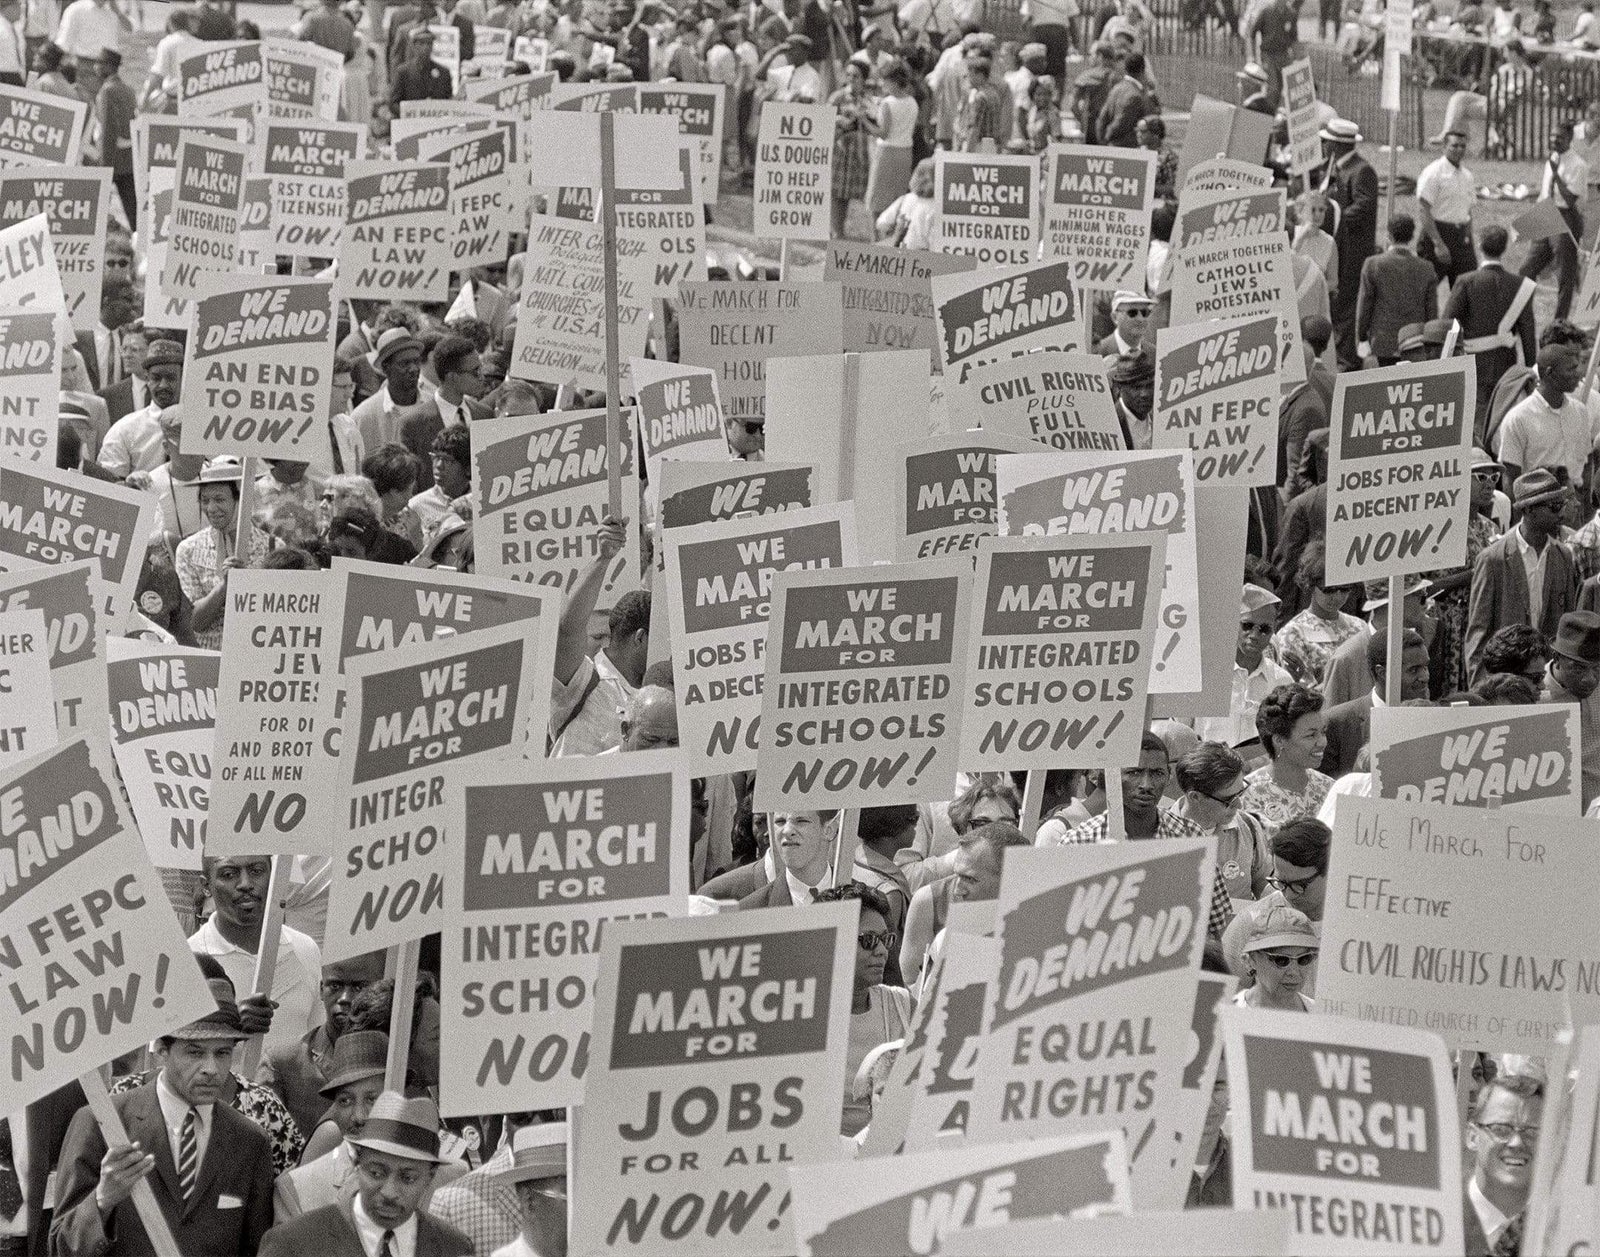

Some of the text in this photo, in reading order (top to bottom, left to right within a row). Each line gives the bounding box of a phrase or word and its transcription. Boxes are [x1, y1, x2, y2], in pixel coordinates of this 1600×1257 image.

[205, 49, 237, 71] WE
[269, 61, 292, 76] WE
[186, 60, 262, 96] DEMAND
[11, 101, 41, 121] WE
[664, 94, 688, 107] WE
[298, 131, 326, 146] WE
[780, 116, 813, 135] NO
[1, 138, 34, 153] FOR
[271, 146, 351, 166] MARCH
[784, 145, 829, 165] DOUGH
[205, 152, 225, 170] WE
[294, 164, 325, 175] FOR
[1086, 158, 1114, 175] WE
[185, 167, 237, 195] MARCH
[379, 172, 418, 194] WE
[767, 171, 819, 186] TO HELP
[972, 167, 999, 183] WE
[1061, 171, 1139, 196] MARCH
[33, 181, 64, 198] WE
[199, 191, 221, 204] FOR
[352, 186, 445, 219] DEMAND
[630, 191, 662, 203] FOR
[759, 189, 825, 206] JIM CROW
[948, 182, 1024, 204] MARCH
[1082, 193, 1112, 205] FOR
[2, 199, 91, 220] MARCH
[461, 193, 502, 213] FEPC
[970, 204, 1000, 215] FOR
[1068, 208, 1126, 223] HIGHER
[1213, 200, 1250, 224] WE
[176, 208, 237, 234] INTEGRATED
[770, 209, 813, 226] GROW
[1049, 219, 1145, 237] MINIMUM WAGES
[353, 226, 446, 244] AN FEPC
[537, 226, 582, 249] INTER
[942, 221, 1030, 241] INTEGRATED
[1052, 233, 1140, 249] COVERAGE FOR
[371, 248, 425, 265] LAW
[855, 253, 905, 277] MARCH
[1053, 245, 1135, 261] ALL WORKERS
[1184, 242, 1284, 269] WE MARCH TOGETHER
[356, 267, 439, 290] NOW!
[1196, 260, 1274, 284] CATHOLIC
[982, 276, 1028, 313] WE
[1212, 277, 1258, 295] JEWS
[240, 288, 291, 318] WE
[711, 289, 767, 310] MARCH
[777, 289, 801, 309] FOR
[1196, 287, 1281, 314] PROTESTANT
[202, 309, 326, 351] DEMAND
[953, 291, 1068, 353] DEMAND
[711, 325, 778, 346] DECENT
[1198, 330, 1240, 365] WE
[519, 345, 582, 370] RELIGION
[205, 361, 320, 387] AN END
[1167, 344, 1272, 402] DEMAND
[205, 388, 316, 414] TO BIAS
[663, 380, 691, 410] WE
[980, 372, 1105, 404] CIVIL RIGHTS
[1387, 382, 1423, 405] WE
[1026, 395, 1075, 414] PLUS
[1165, 397, 1271, 430] AN FEPC
[203, 415, 313, 445] NOW!
[651, 402, 718, 447] DEMAND
[1029, 411, 1087, 434] FULL
[1350, 402, 1455, 438] MARCH
[528, 424, 583, 463] WE
[1188, 425, 1250, 450] LAW
[1382, 435, 1423, 450] FOR
[1336, 458, 1461, 492] JOBS FOR ALL
[43, 486, 86, 518] WE
[711, 478, 766, 516] WE
[1062, 468, 1127, 511] WE
[1333, 488, 1461, 522] A DECENT PAY
[25, 541, 74, 564] FOR
[737, 537, 785, 565] WE
[1345, 517, 1452, 568] NOW!
[1048, 555, 1095, 579] WE
[234, 593, 319, 614] WE MARCH
[415, 589, 473, 622] WE
[847, 587, 897, 613] WE
[997, 580, 1135, 612] MARCH
[795, 612, 942, 649] MARCH
[1038, 614, 1090, 629] FOR
[684, 641, 747, 670] JOBS
[839, 649, 895, 665] FOR
[977, 639, 1140, 670] INTEGRATED
[139, 658, 188, 692] WE
[419, 661, 467, 699] WE
[685, 684, 705, 706] A
[777, 674, 951, 709] INTEGRATED
[973, 677, 1134, 708] SCHOOLS
[260, 717, 289, 733] FOR
[368, 685, 508, 752] MARCH
[774, 712, 945, 747] SCHOOLS
[979, 709, 1124, 754] NOW!
[229, 741, 262, 758] AND
[407, 735, 462, 765] FOR
[1440, 725, 1510, 771] WE
[221, 766, 303, 781] OF ALL MEN
[781, 746, 937, 794] NOW!
[543, 788, 604, 823] WE
[480, 822, 657, 876] MARCH
[538, 876, 606, 900] FOR
[27, 874, 146, 956] FEPC
[1065, 869, 1147, 935] WE
[698, 943, 762, 981] WE
[1005, 906, 1193, 1011] DEMAND
[1340, 939, 1567, 993] CIVIL RIGHTS LAWS
[8, 931, 125, 1016] LAW
[12, 953, 169, 1082] NOW!
[628, 977, 817, 1034] MARCH
[685, 1032, 757, 1057] FOR
[1012, 1017, 1157, 1067] EQUAL
[1312, 1052, 1372, 1094] WE
[618, 1076, 805, 1142] JOBS
[1001, 1071, 1157, 1122] RIGHTS
[1264, 1090, 1427, 1152] MARCH
[620, 1143, 794, 1175] FOR ALL
[1316, 1150, 1381, 1178] FOR
